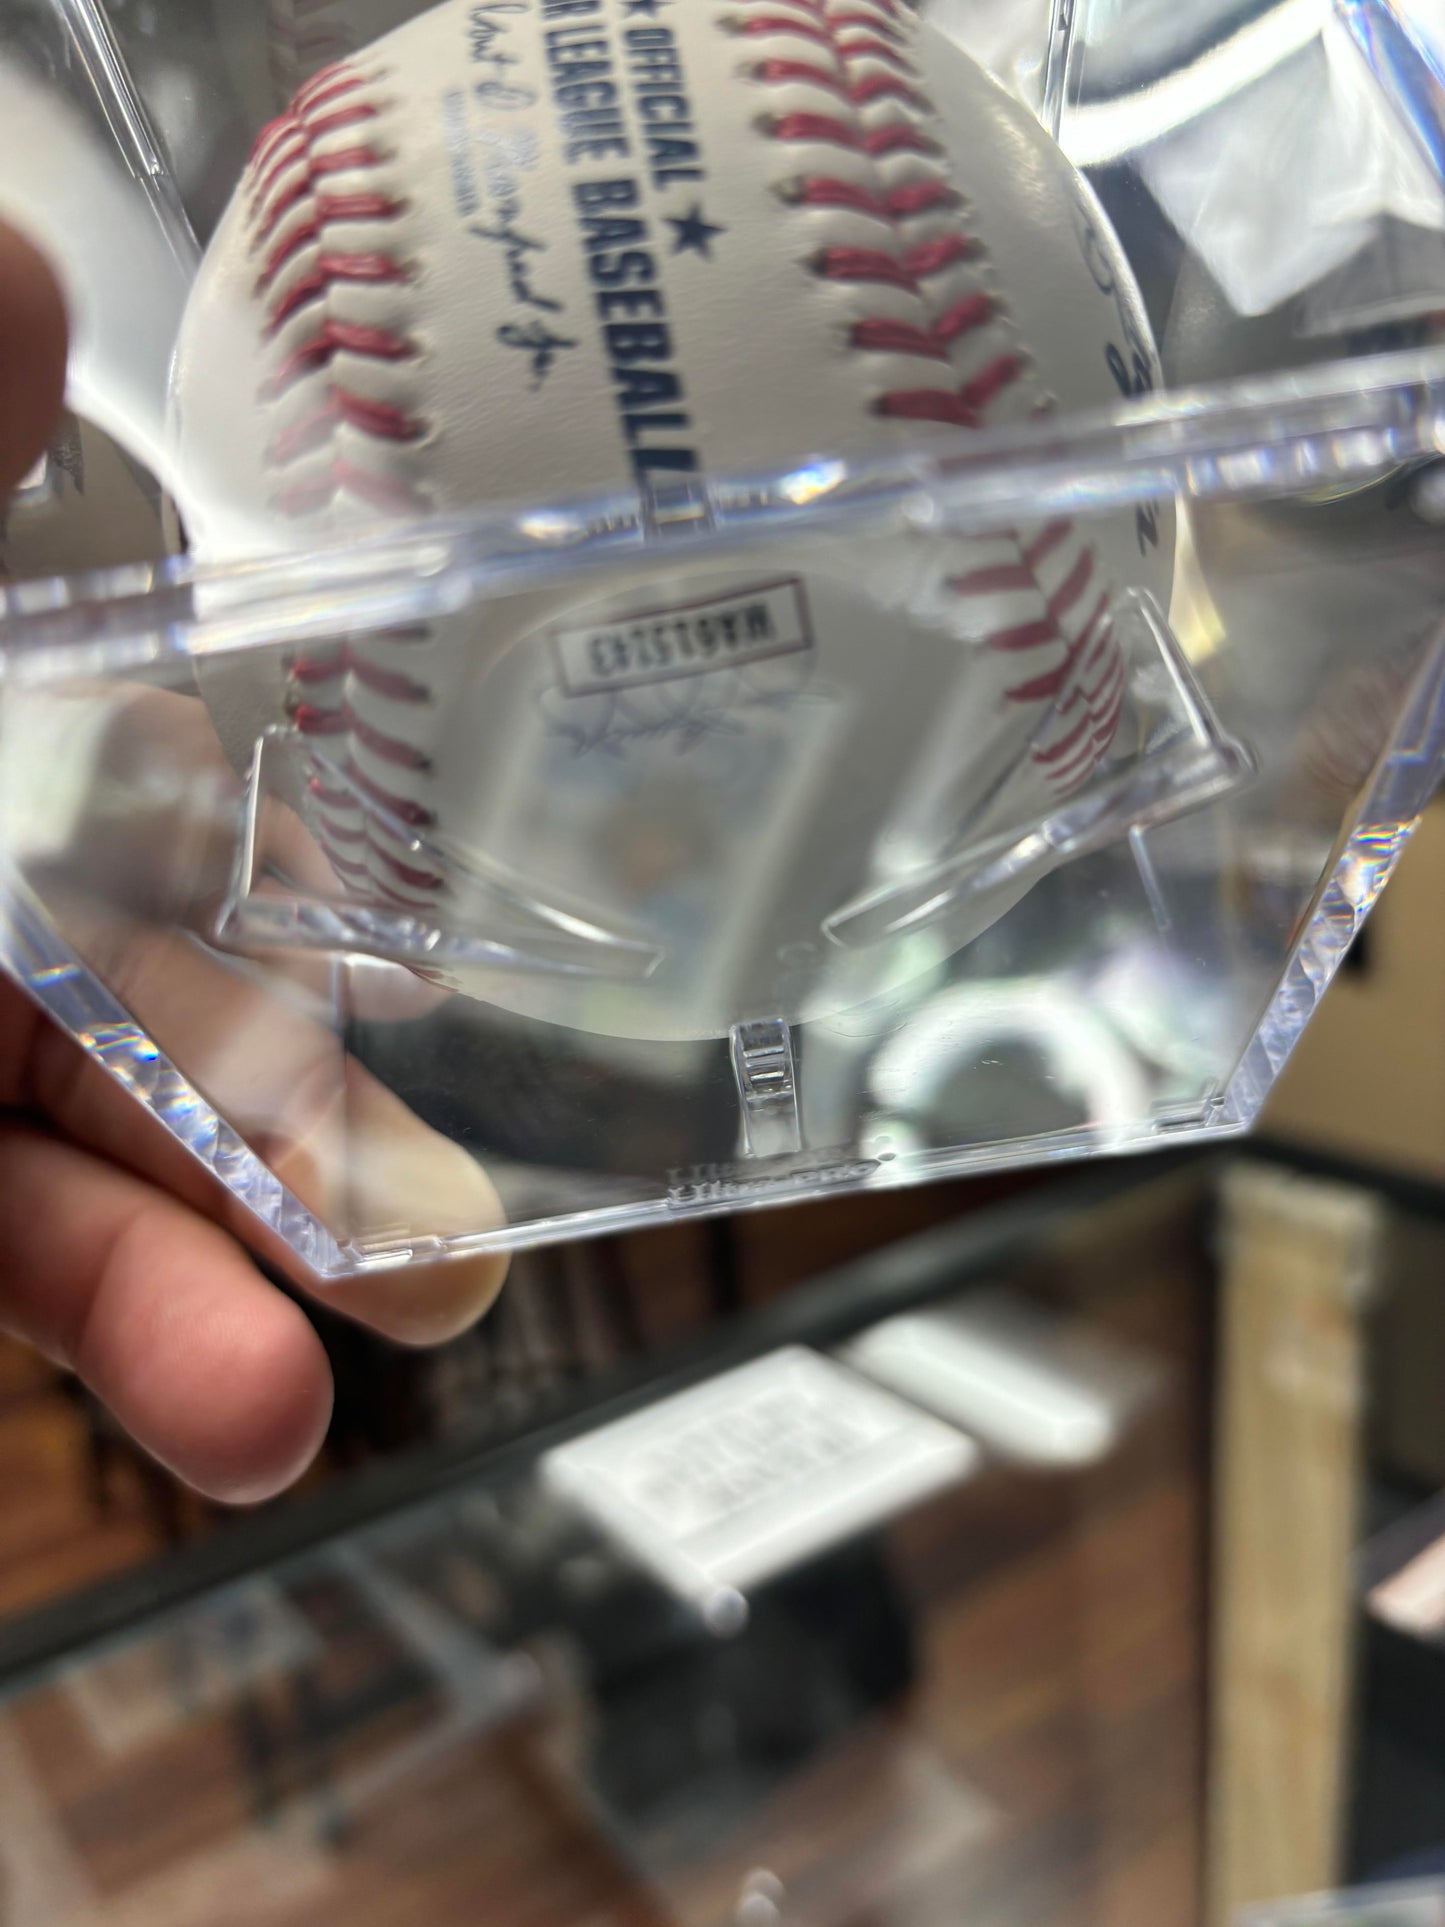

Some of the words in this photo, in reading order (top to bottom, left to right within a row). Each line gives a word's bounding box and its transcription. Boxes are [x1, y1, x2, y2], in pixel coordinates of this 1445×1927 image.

[545, 23, 631, 166] LEAGUE
[625, 27, 706, 193] OFFICIAL
[572, 177, 702, 494] BASEBALL
